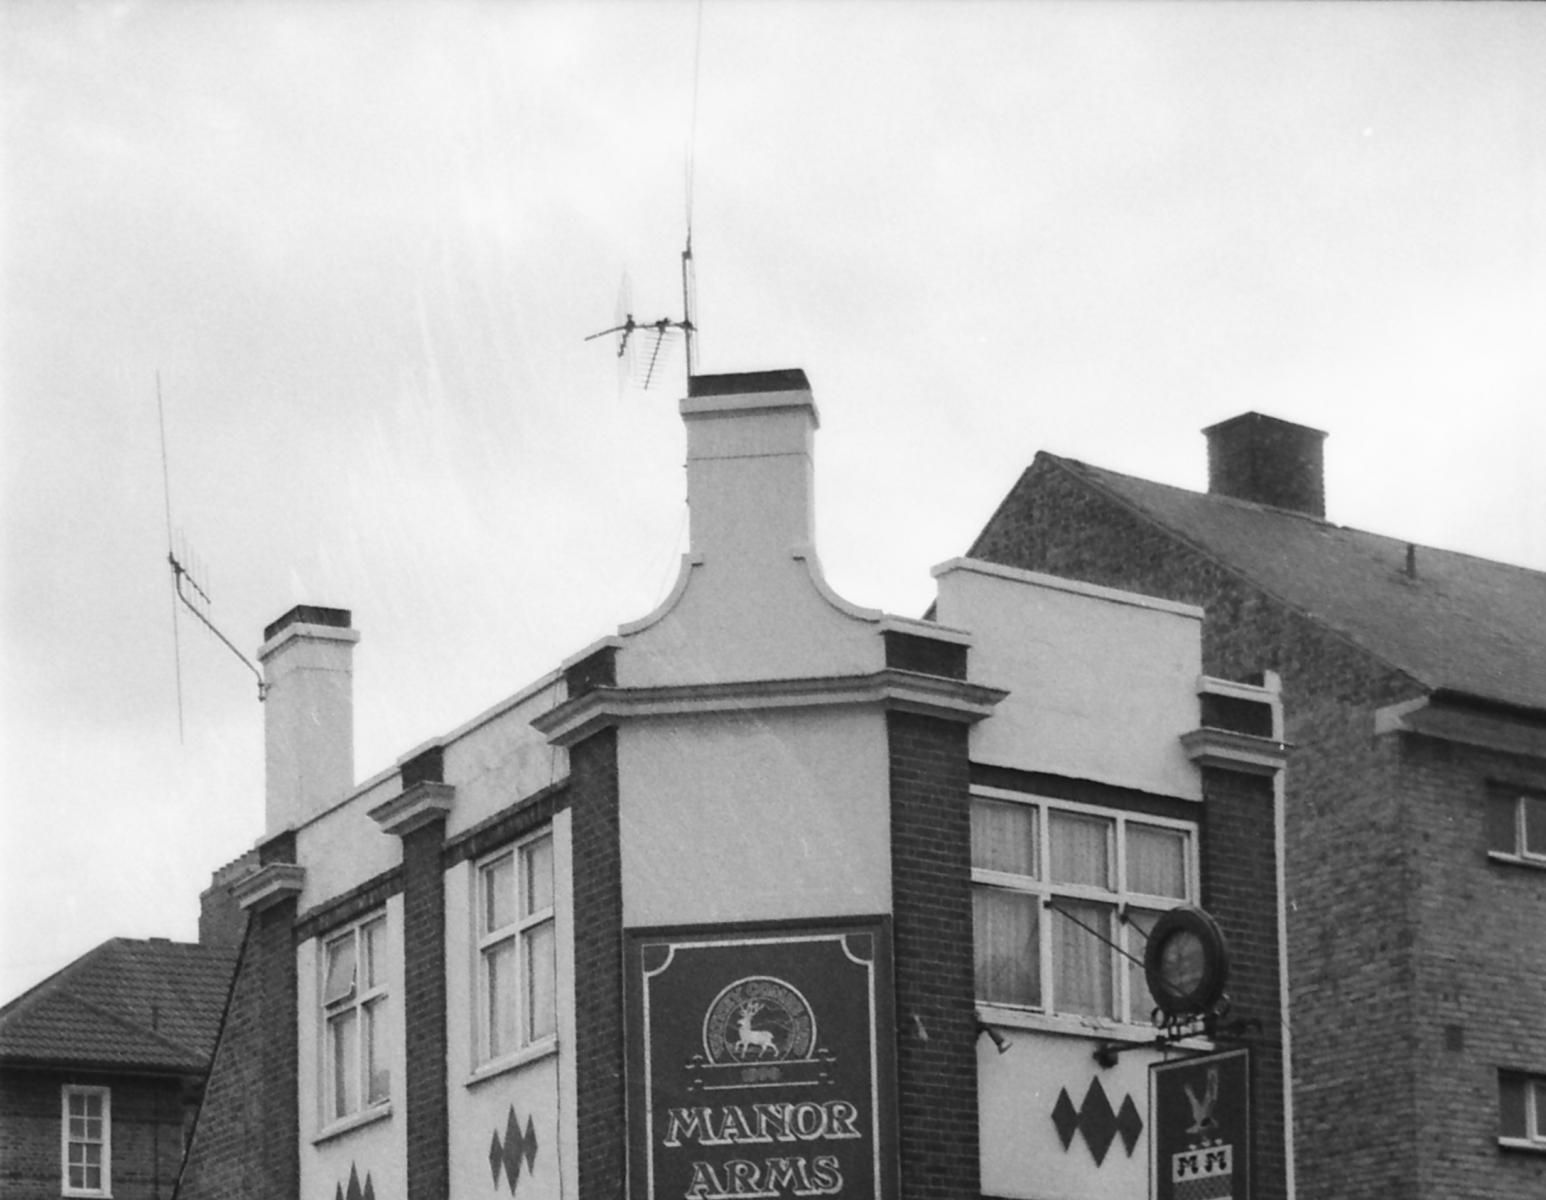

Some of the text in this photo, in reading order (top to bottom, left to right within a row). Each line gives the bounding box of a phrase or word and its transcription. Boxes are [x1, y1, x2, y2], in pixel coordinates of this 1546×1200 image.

[663, 1101, 862, 1147] MANOR
[684, 1156, 844, 1200] ARMS
[1177, 1150, 1227, 1176] M M
